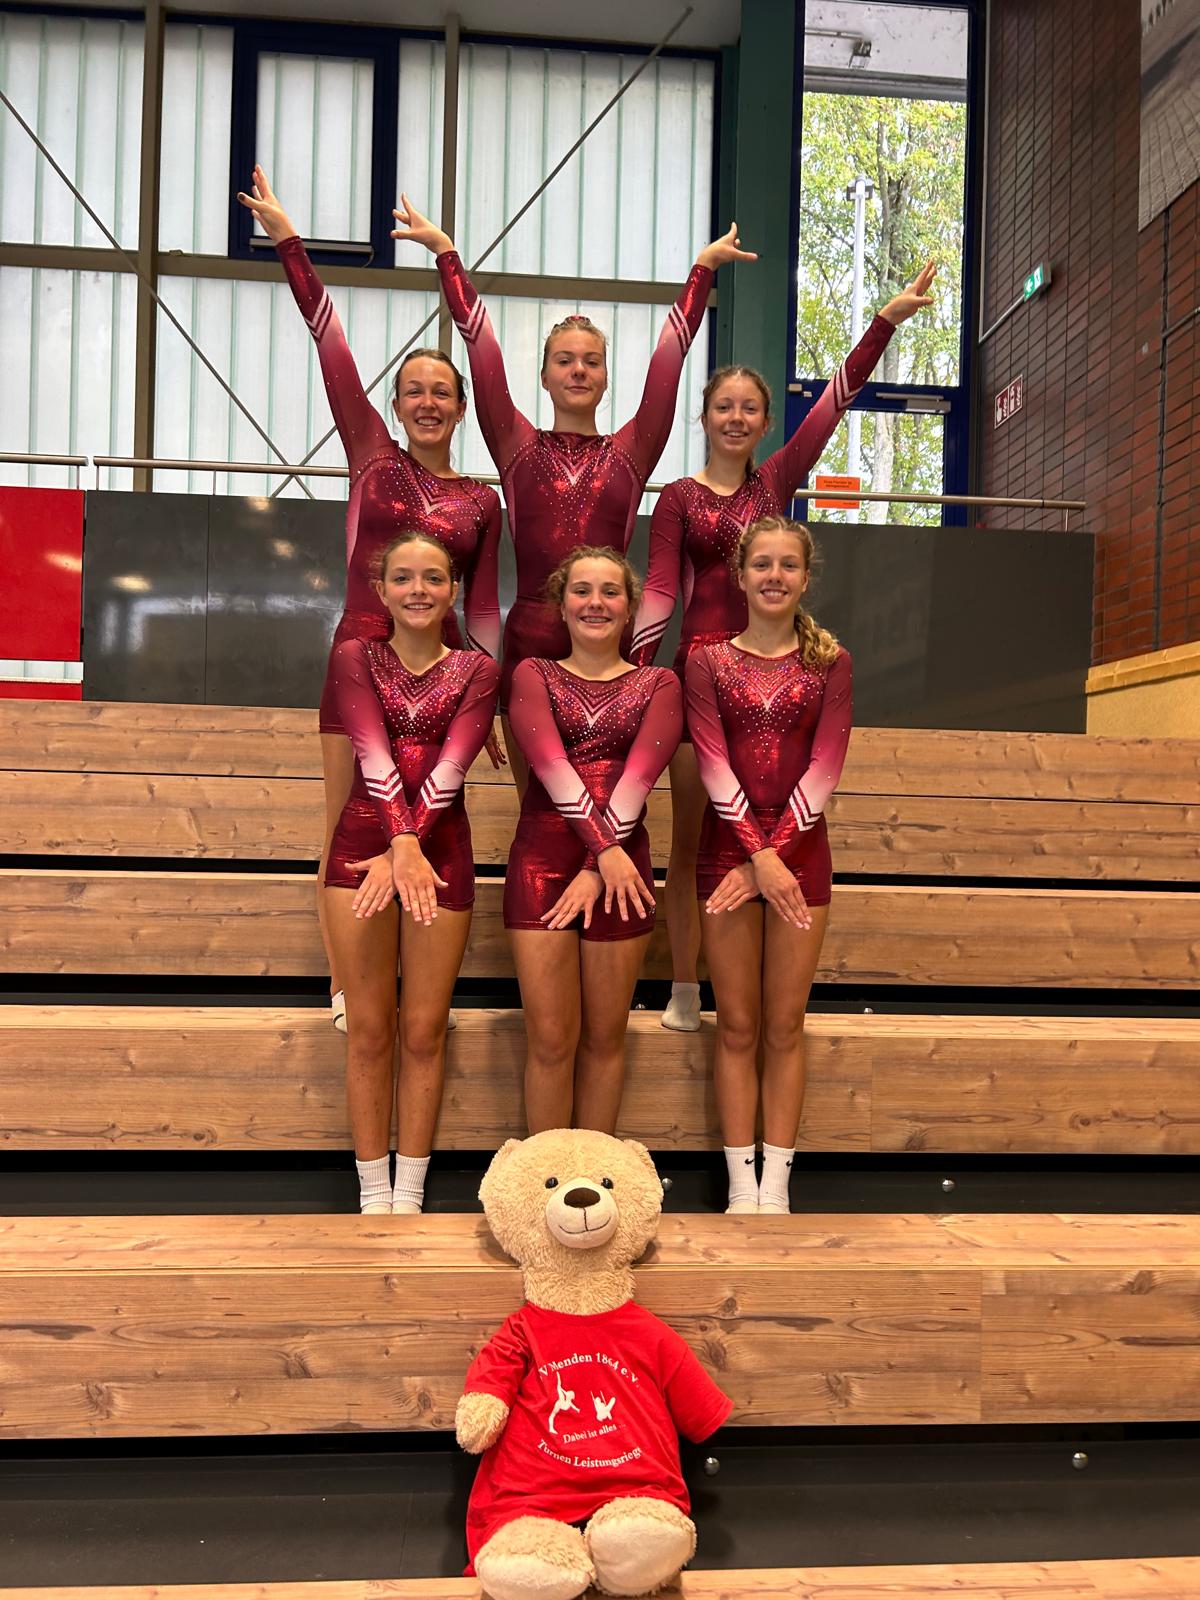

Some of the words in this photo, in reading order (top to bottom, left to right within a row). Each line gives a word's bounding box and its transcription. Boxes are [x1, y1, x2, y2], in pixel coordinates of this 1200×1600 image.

[548, 1353, 592, 1371] Menden
[596, 1352, 619, 1370] 1864
[563, 1431, 587, 1444] Dabei
[587, 1430, 598, 1438] ist
[599, 1423, 617, 1435] alles
[537, 1439, 572, 1464] Turnen
